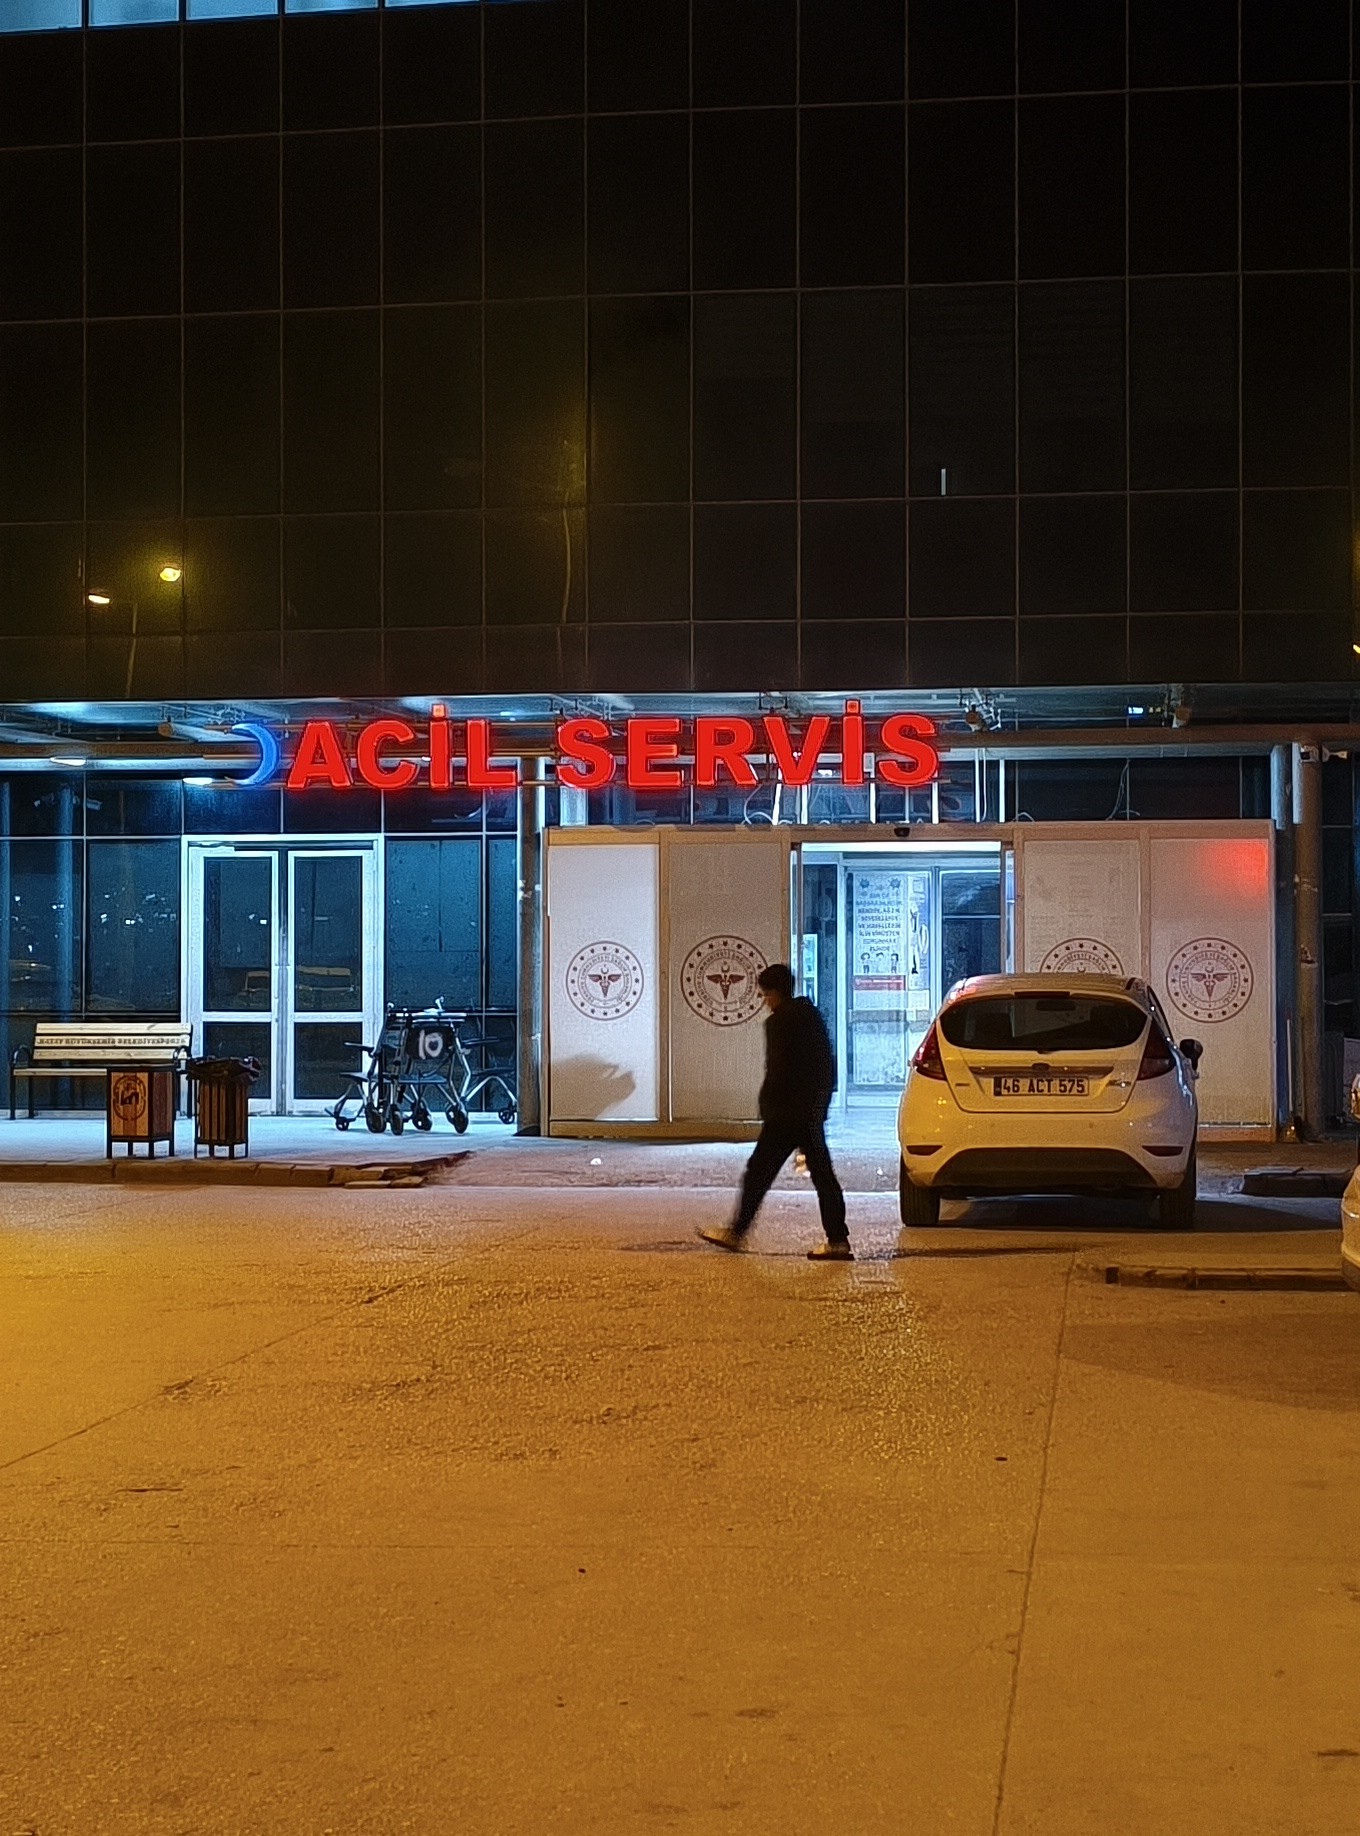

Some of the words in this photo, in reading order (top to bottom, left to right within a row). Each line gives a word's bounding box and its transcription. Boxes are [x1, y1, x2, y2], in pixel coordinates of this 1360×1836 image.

[287, 703, 518, 789] ACİL
[556, 700, 939, 788] SERVİS
[1002, 1078, 1021, 1094] 46
[1027, 1078, 1055, 1094] ACT
[1058, 1078, 1086, 1094] 575
